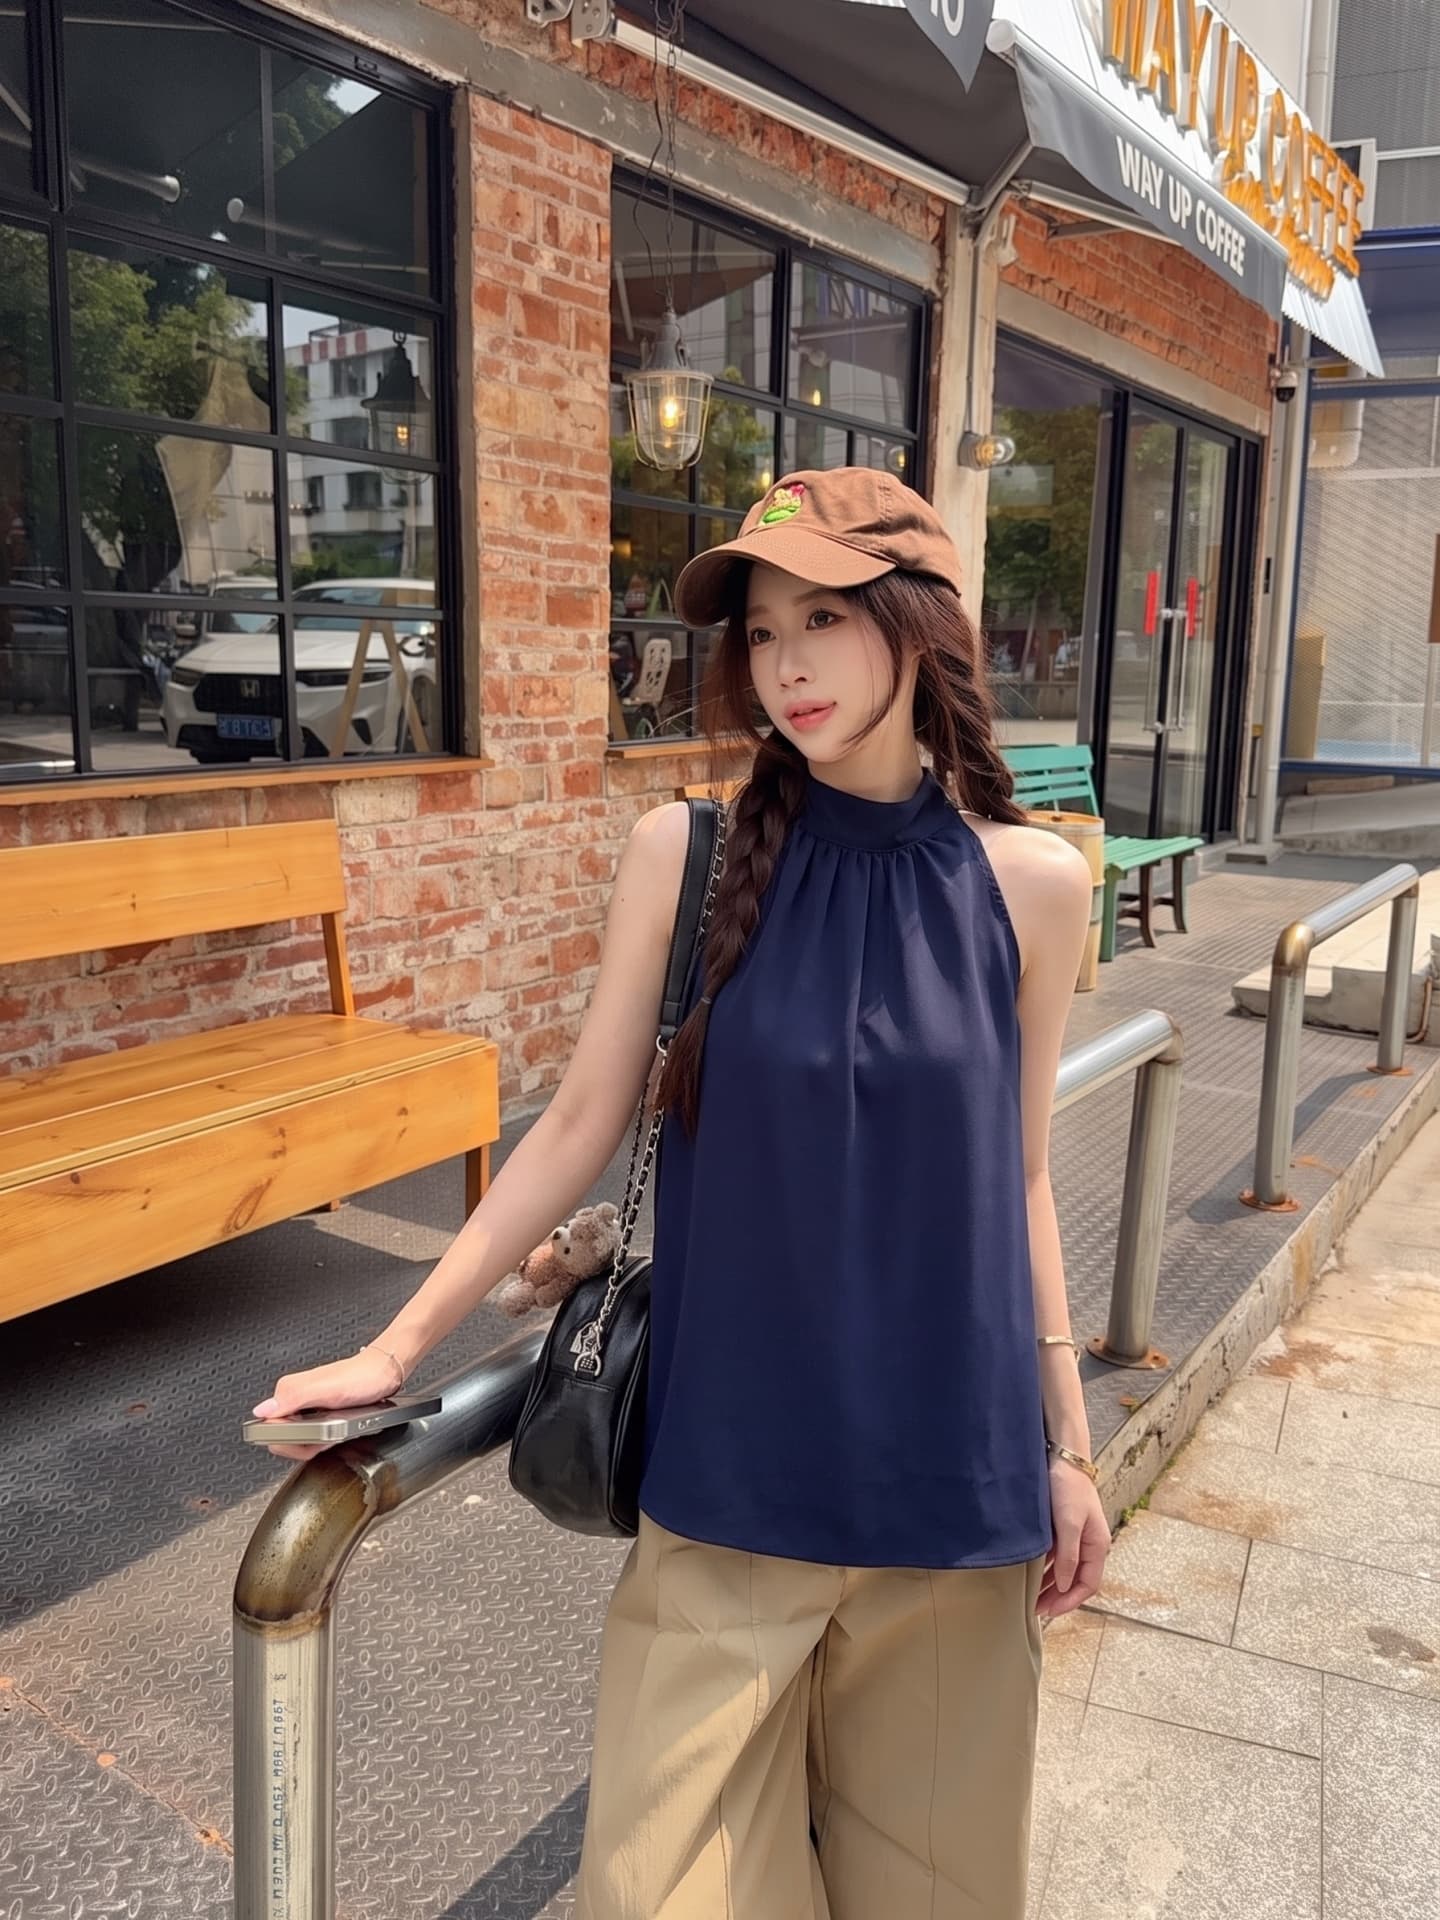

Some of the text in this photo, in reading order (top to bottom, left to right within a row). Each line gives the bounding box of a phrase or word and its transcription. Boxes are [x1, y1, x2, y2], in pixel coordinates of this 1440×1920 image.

[1116, 135, 1246, 277] WAY UP COFFEE
[1208, 20, 1259, 175] UP
[1261, 87, 1365, 278] COFFEE
